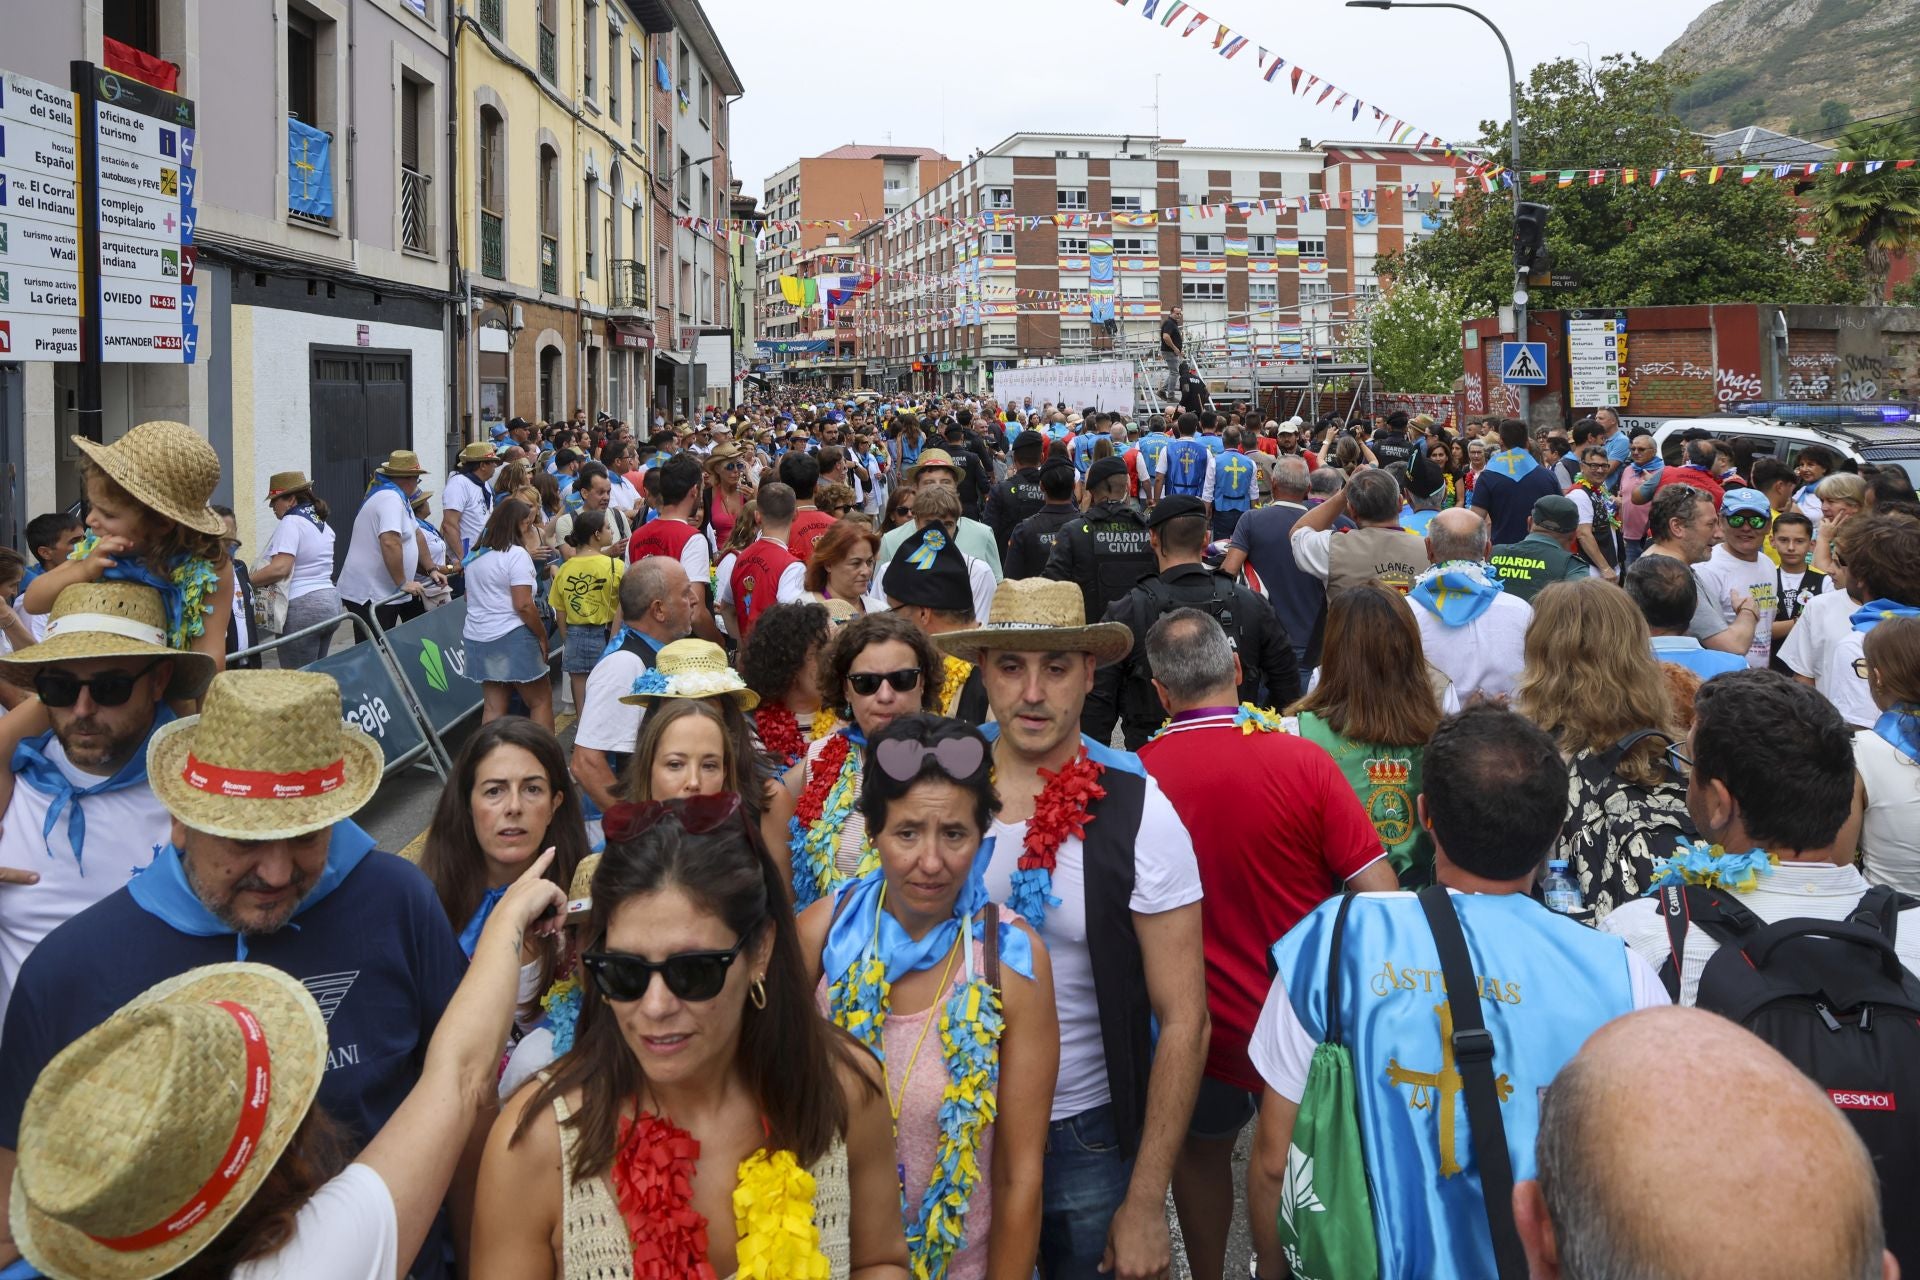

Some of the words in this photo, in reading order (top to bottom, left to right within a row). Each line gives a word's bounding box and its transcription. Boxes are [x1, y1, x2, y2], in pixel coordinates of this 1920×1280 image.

[12, 84, 32, 98] hotel
[36, 88, 72, 109] Casona
[30, 104, 46, 118] del
[50, 109, 72, 125] Sella
[100, 110, 131, 127] oficina
[134, 118, 144, 131] de
[100, 126, 136, 143] turismo
[52, 142, 74, 154] hostal
[36, 152, 74, 172] Español
[101, 155, 129, 168] estación
[130, 162, 139, 170] de
[102, 171, 136, 185] autobuses
[137, 180, 142, 188] y
[143, 180, 160, 190] FEVE
[12, 180, 27, 190] rte.
[30, 180, 40, 191] El
[43, 183, 74, 200] Corral
[18, 195, 34, 208] del
[38, 198, 75, 216] Indianu
[102, 198, 144, 214] complejo
[102, 212, 156, 230] hospitalario
[24, 230, 52, 241] turismo
[54, 234, 76, 245] activo
[50, 247, 76, 261] Wadi
[102, 241, 158, 258] arquitectura
[102, 257, 136, 269] indiana
[24, 278, 53, 288] turismo
[55, 280, 77, 290] activo
[30, 291, 42, 304] La
[46, 292, 77, 306] Grieta
[104, 291, 142, 305] OVIEDO
[152, 296, 176, 308] N-634
[52, 326, 77, 336] puente
[36, 339, 78, 354] Piraguas
[104, 336, 152, 347] SANTANDER
[154, 338, 182, 348] N-634
[1618, 420, 1639, 428] LTO
[1096, 532, 1150, 543] GUARDIA
[1108, 542, 1142, 553] CIVIL
[1374, 562, 1416, 575] LLANES
[1490, 555, 1546, 570] GUARDIA
[1498, 568, 1532, 580] CIVIL
[346, 693, 391, 738] caja
[222, 780, 252, 792] Alcampo
[273, 784, 304, 792] Alcampo
[1668, 886, 1680, 916] Canon
[1371, 961, 1521, 1004] ASTIAS
[325, 1044, 360, 1071] ANI
[1833, 1093, 1888, 1106] BESCHOI
